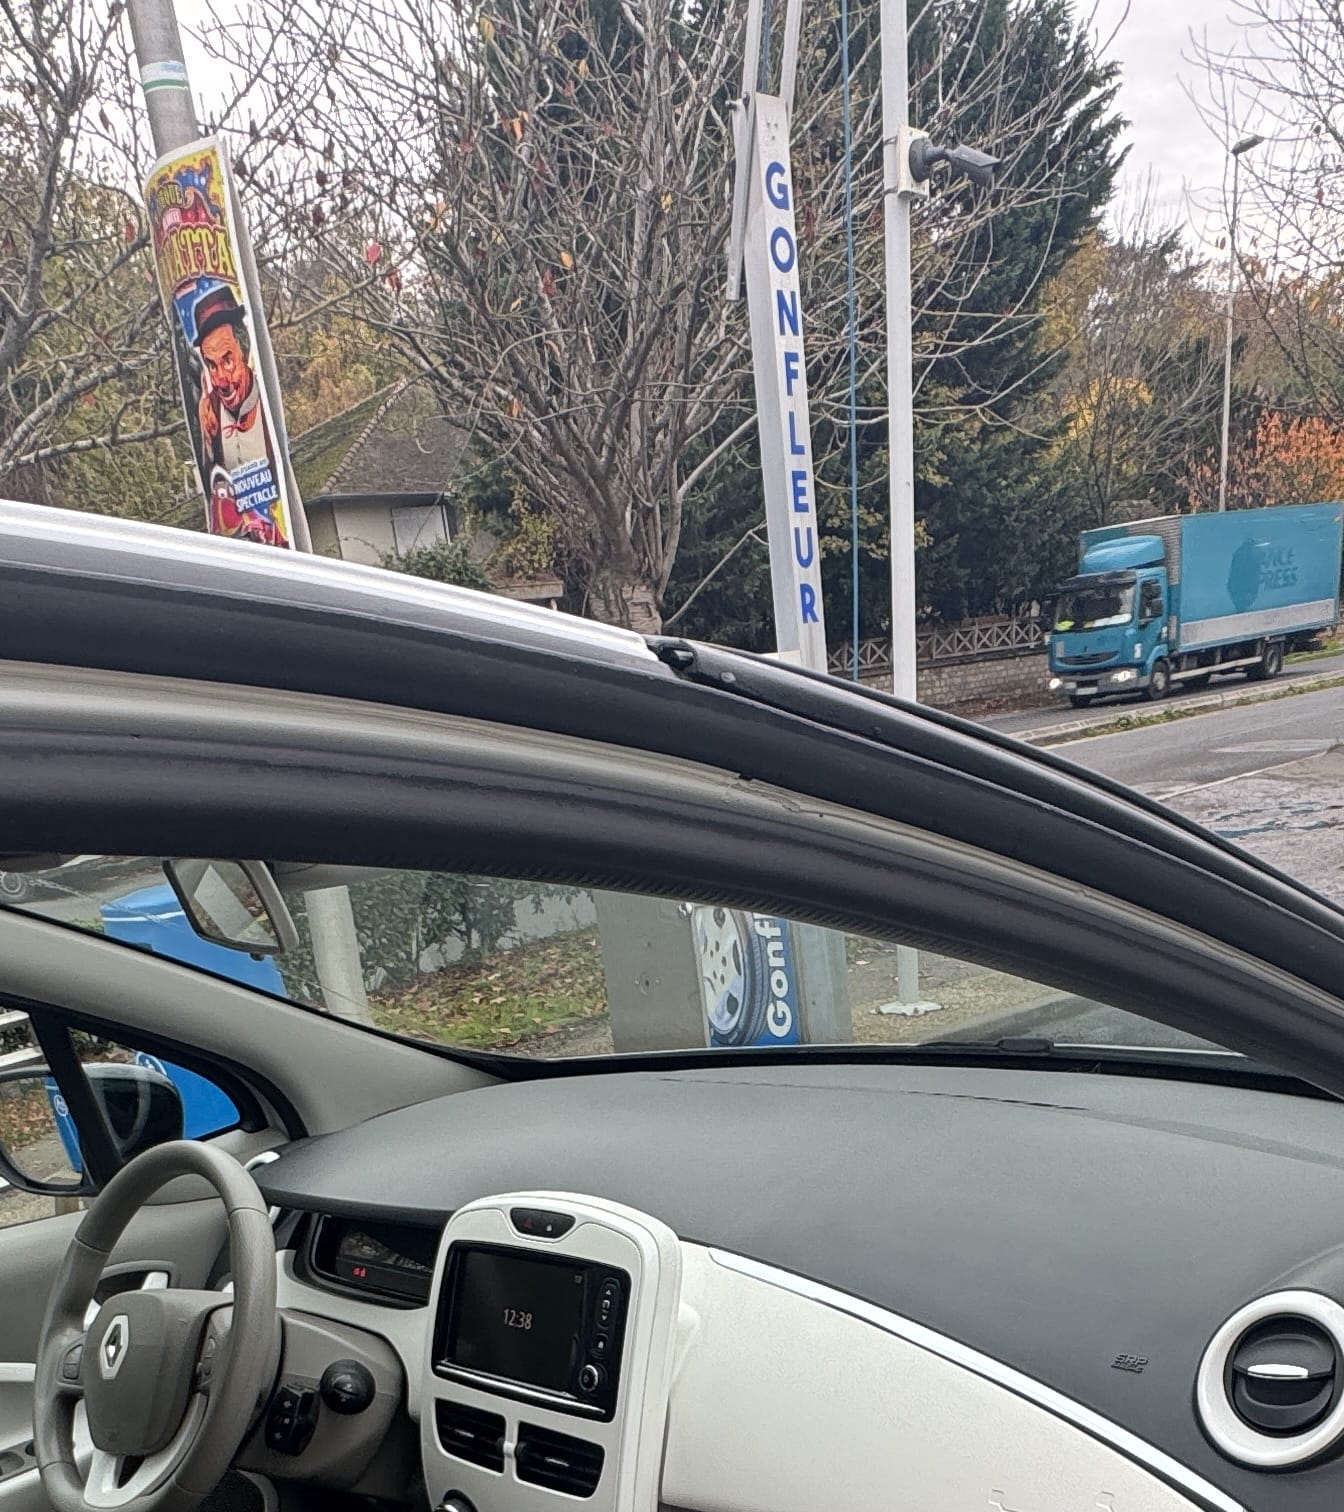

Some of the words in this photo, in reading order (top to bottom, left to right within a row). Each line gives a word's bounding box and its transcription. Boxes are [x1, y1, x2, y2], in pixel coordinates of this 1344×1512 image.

[764, 160, 821, 625] GONFLEUR
[234, 468, 273, 496] NOUVEAU
[236, 484, 278, 513] SPECTACLE
[503, 1308, 533, 1330] 12:38
